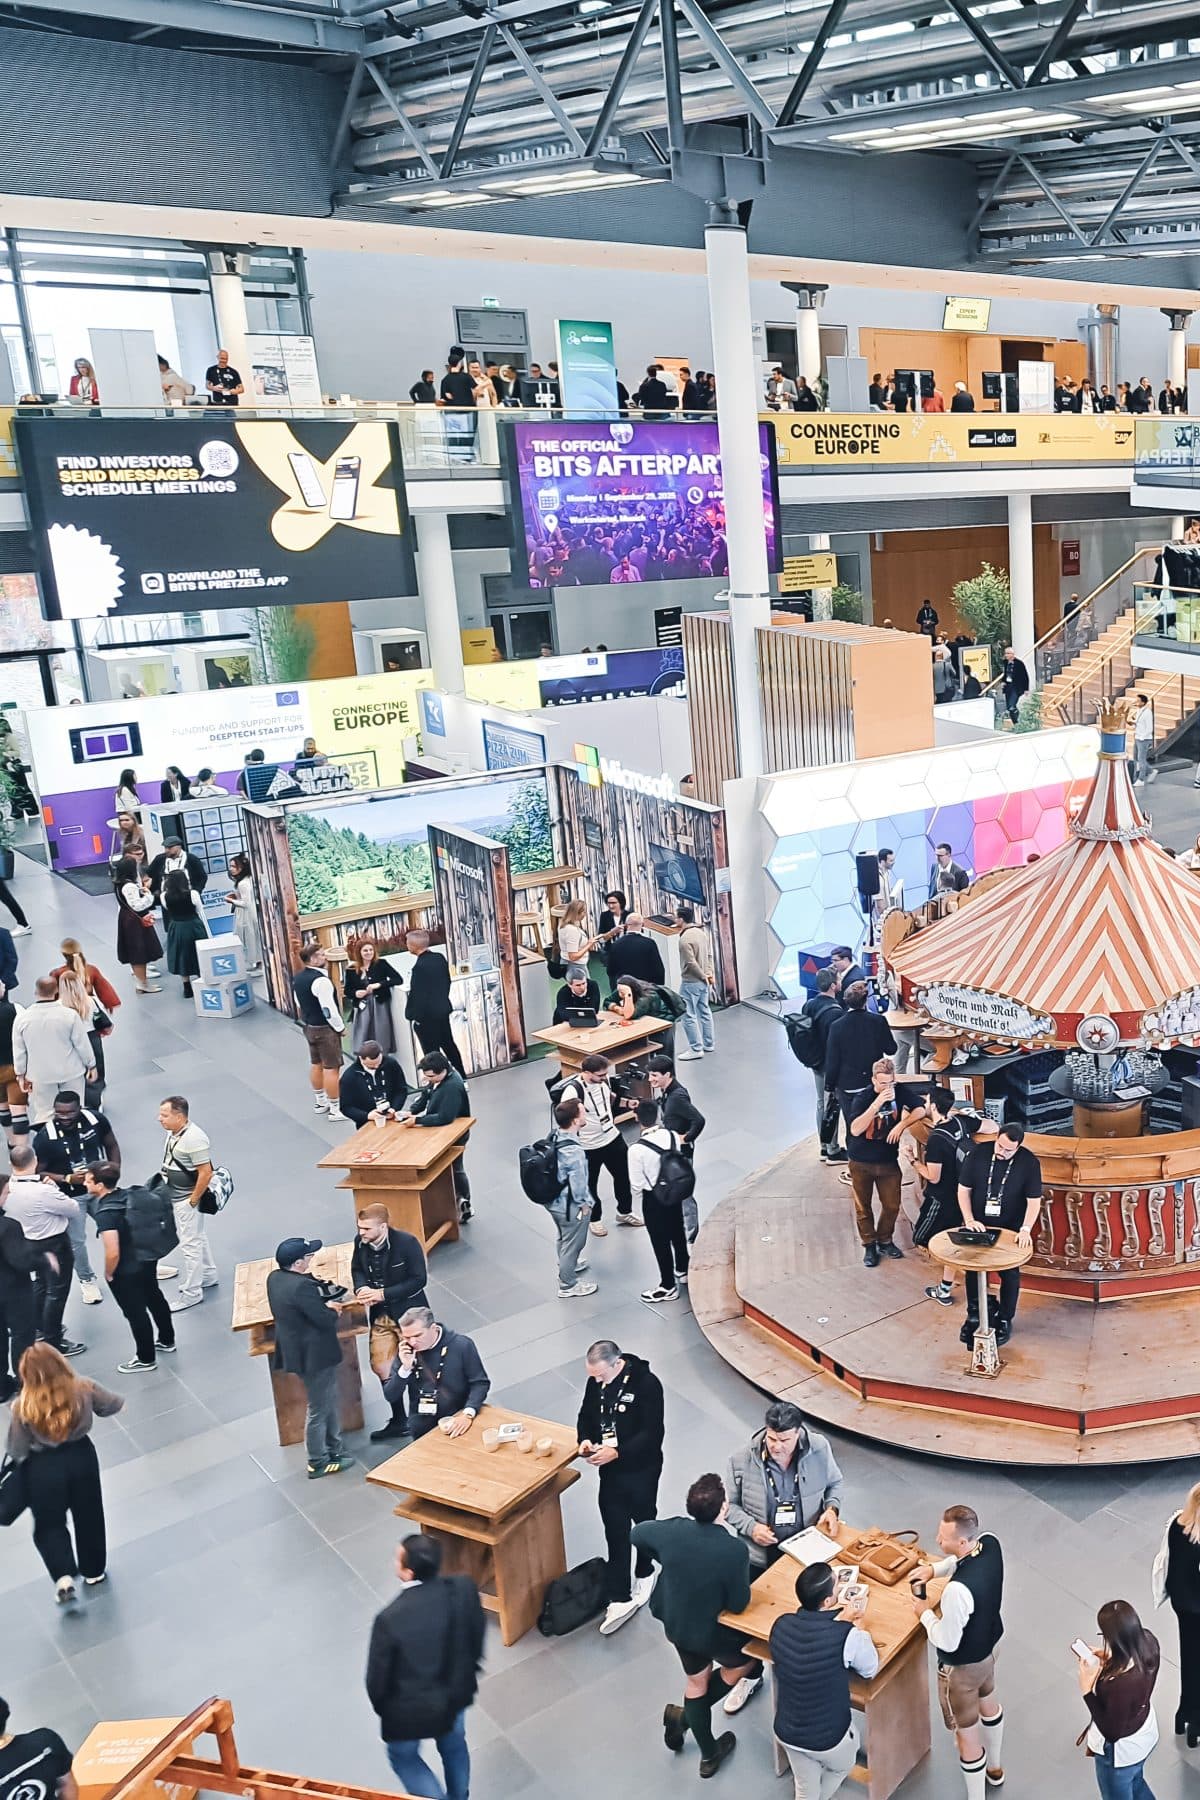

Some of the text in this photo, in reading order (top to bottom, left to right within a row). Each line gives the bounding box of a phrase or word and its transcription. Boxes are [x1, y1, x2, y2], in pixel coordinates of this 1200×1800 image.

[790, 423, 900, 439] CONNECTING
[1115, 431, 1131, 444] SAP
[531, 439, 622, 453] THE OFFICIAL
[815, 440, 881, 455] EUROPE
[57, 455, 193, 470] FIND INVESTORS
[534, 455, 592, 478] BITS
[59, 468, 199, 483] SEND MESSAGES
[62, 481, 237, 496] SCHEDULE MEETINGS
[167, 568, 261, 582] DOWNLOAD THE
[169, 576, 288, 592] BITS & PRETZELS APP
[332, 700, 408, 717] CONNECTING
[171, 714, 303, 736] FUNDING AND SUPPORT FOR
[333, 710, 410, 731] EUROPE
[209, 724, 305, 742] DEEPTECH START-UPS
[600, 757, 676, 803] Microsoft
[450, 856, 485, 882] Microsoft
[937, 992, 1018, 1019] Hopfen und Malz
[946, 1008, 967, 1023] Gott
